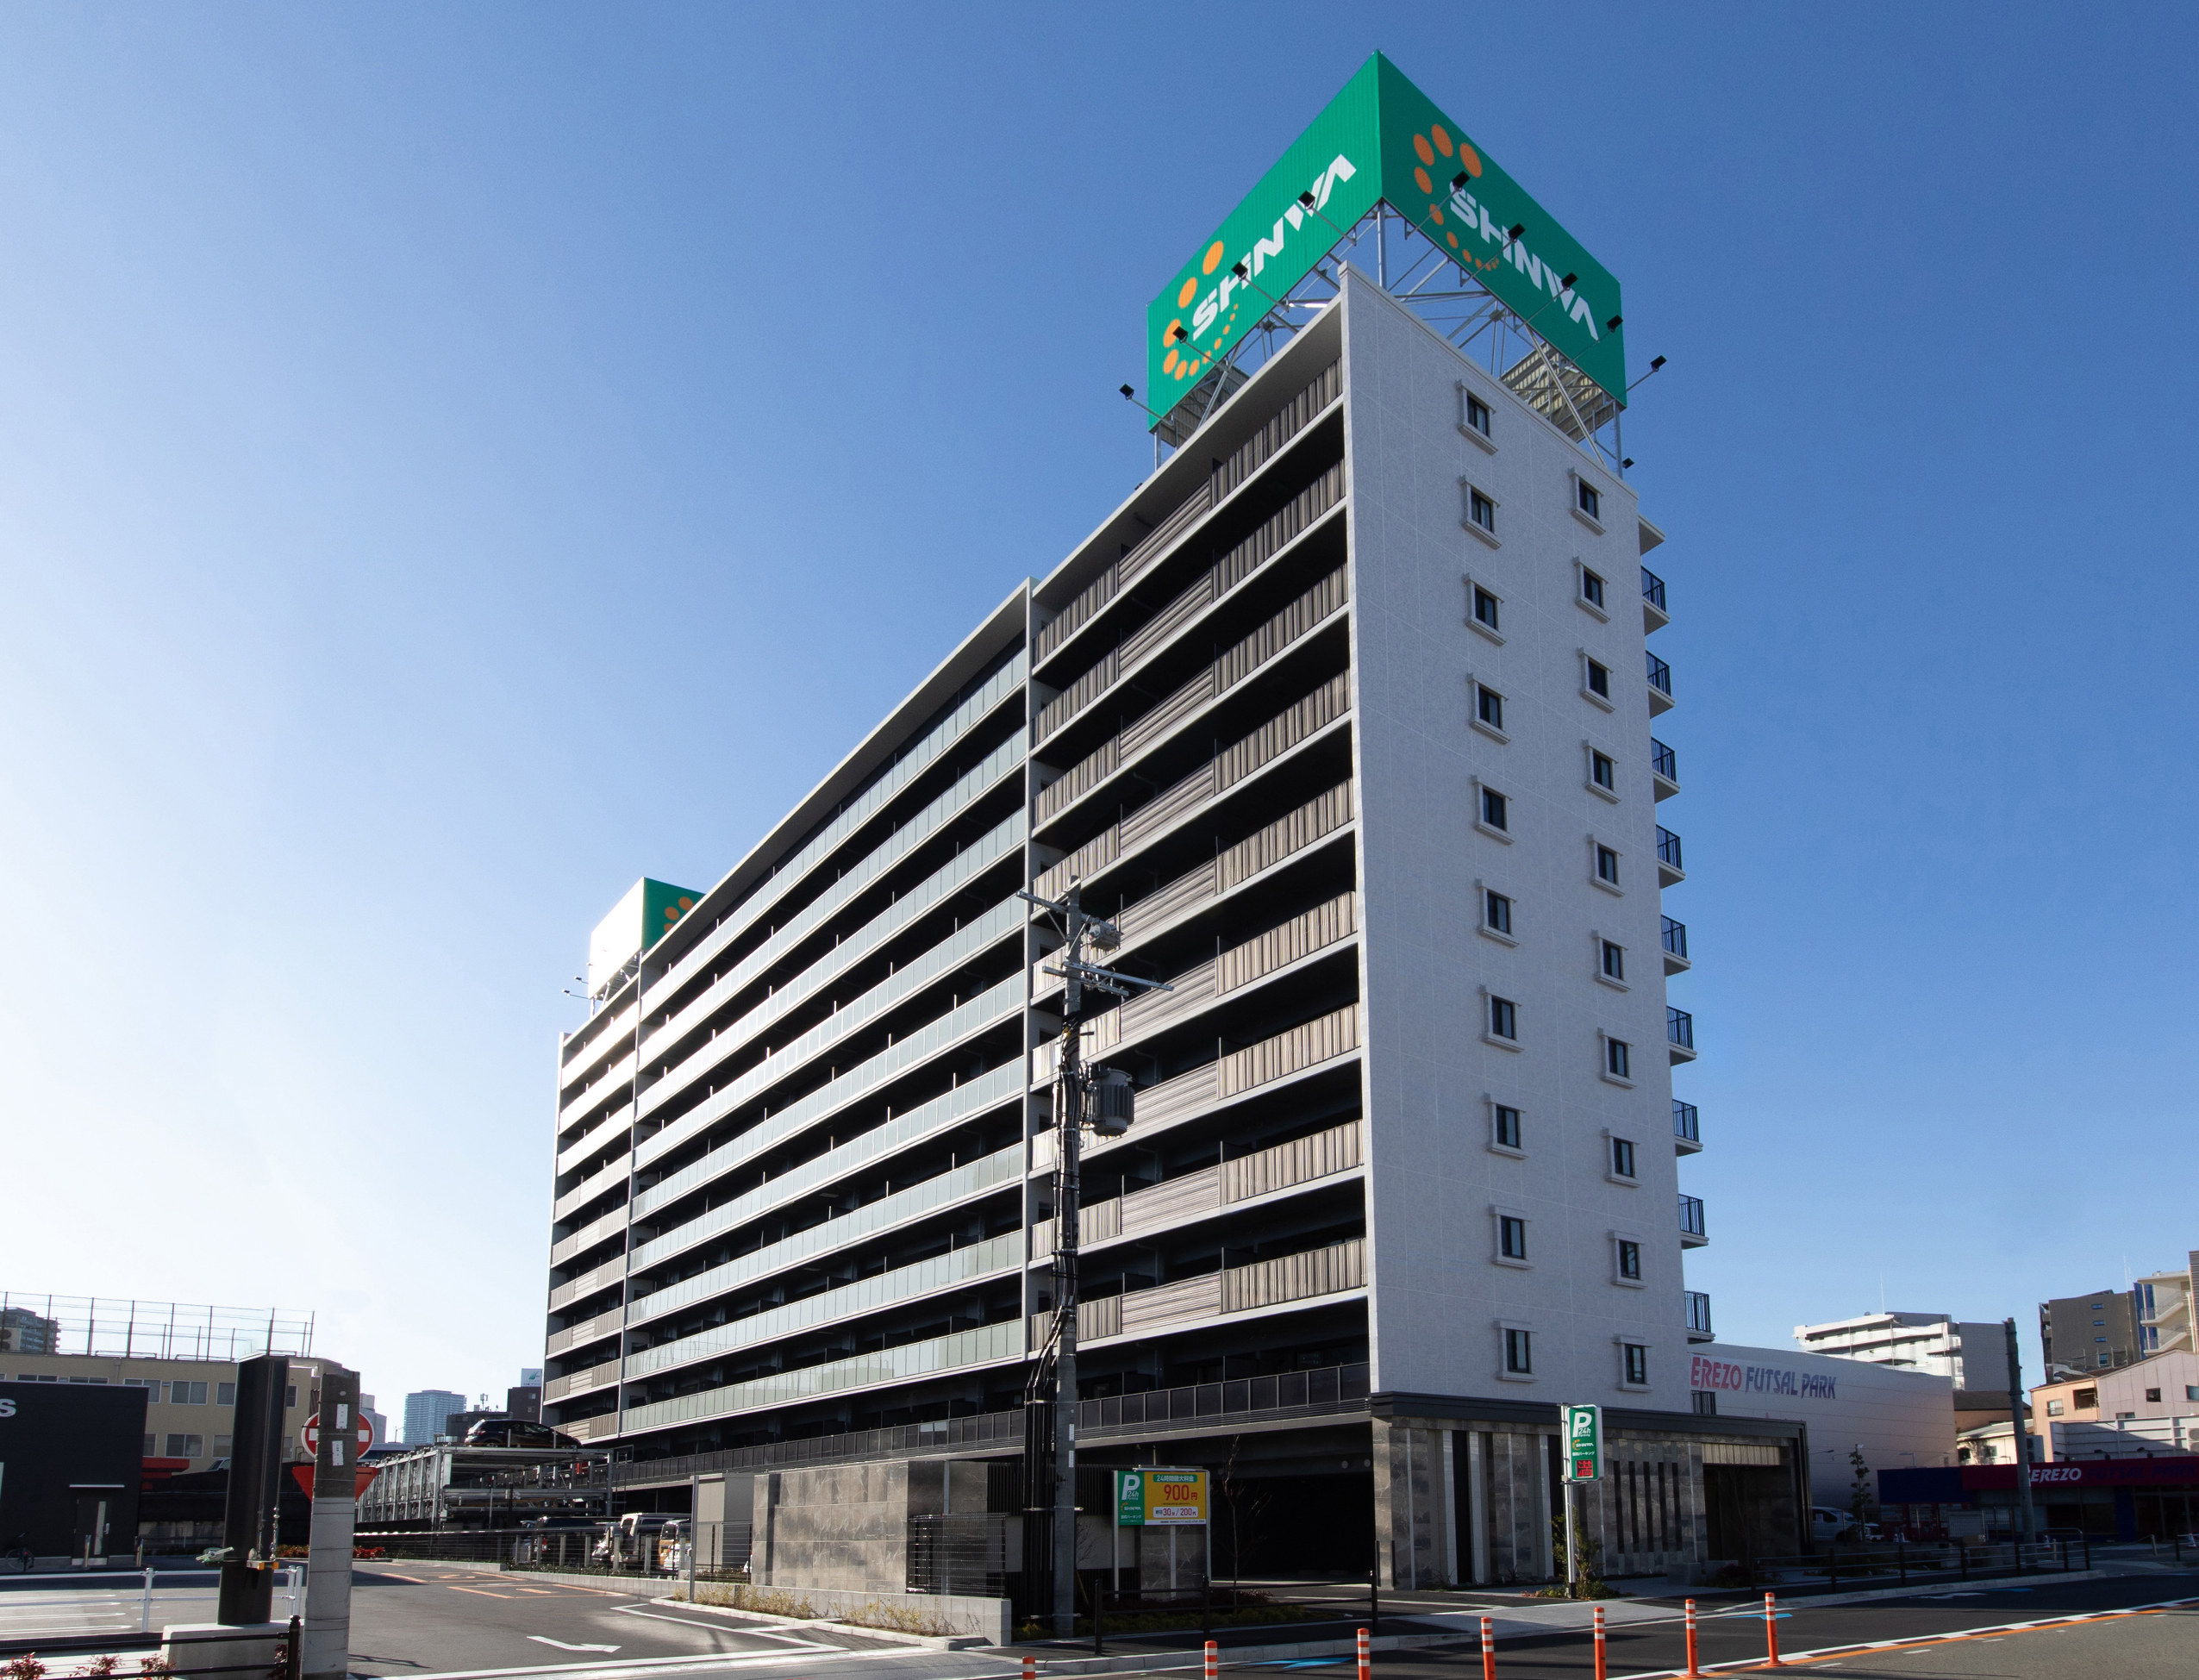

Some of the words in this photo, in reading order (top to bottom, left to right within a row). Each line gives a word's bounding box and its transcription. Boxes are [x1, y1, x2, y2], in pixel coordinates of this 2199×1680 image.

[1192, 153, 1357, 341] SHINWA
[1449, 180, 1600, 343] SHINWA
[1746, 1366, 1798, 1394] FUTSAL
[1801, 1372, 1837, 1399] PARK
[1572, 1412, 1592, 1437] P
[1577, 1460, 1593, 1477] 満
[2029, 1467, 2082, 1483] EREZO
[2086, 1466, 2146, 1480] FUTSAL
[1121, 1475, 1140, 1500] P
